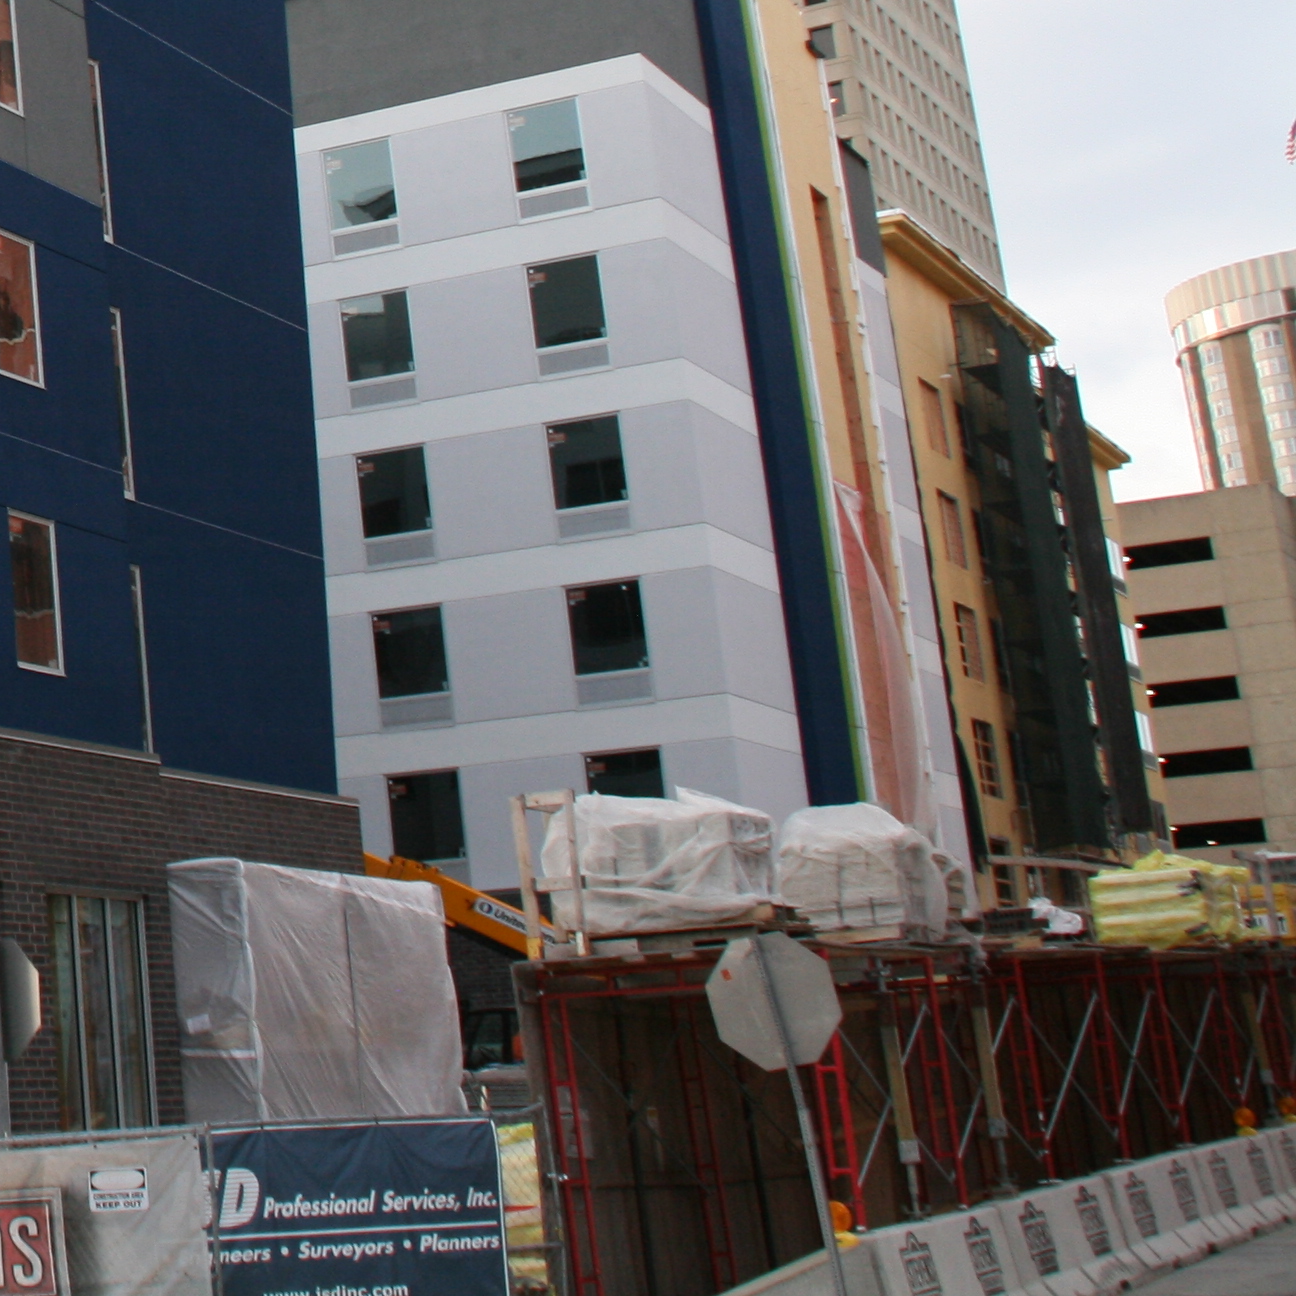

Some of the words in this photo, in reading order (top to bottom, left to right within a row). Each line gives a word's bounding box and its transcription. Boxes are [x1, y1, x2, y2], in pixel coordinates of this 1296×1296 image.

[95, 1201, 120, 1209] KEEP
[123, 1199, 142, 1208] OUT
[263, 1189, 377, 1220] Professional
[382, 1187, 461, 1214] Services,
[467, 1186, 498, 1208] Inc.
[298, 1240, 395, 1263] Surveyors
[420, 1233, 501, 1254] Planners
